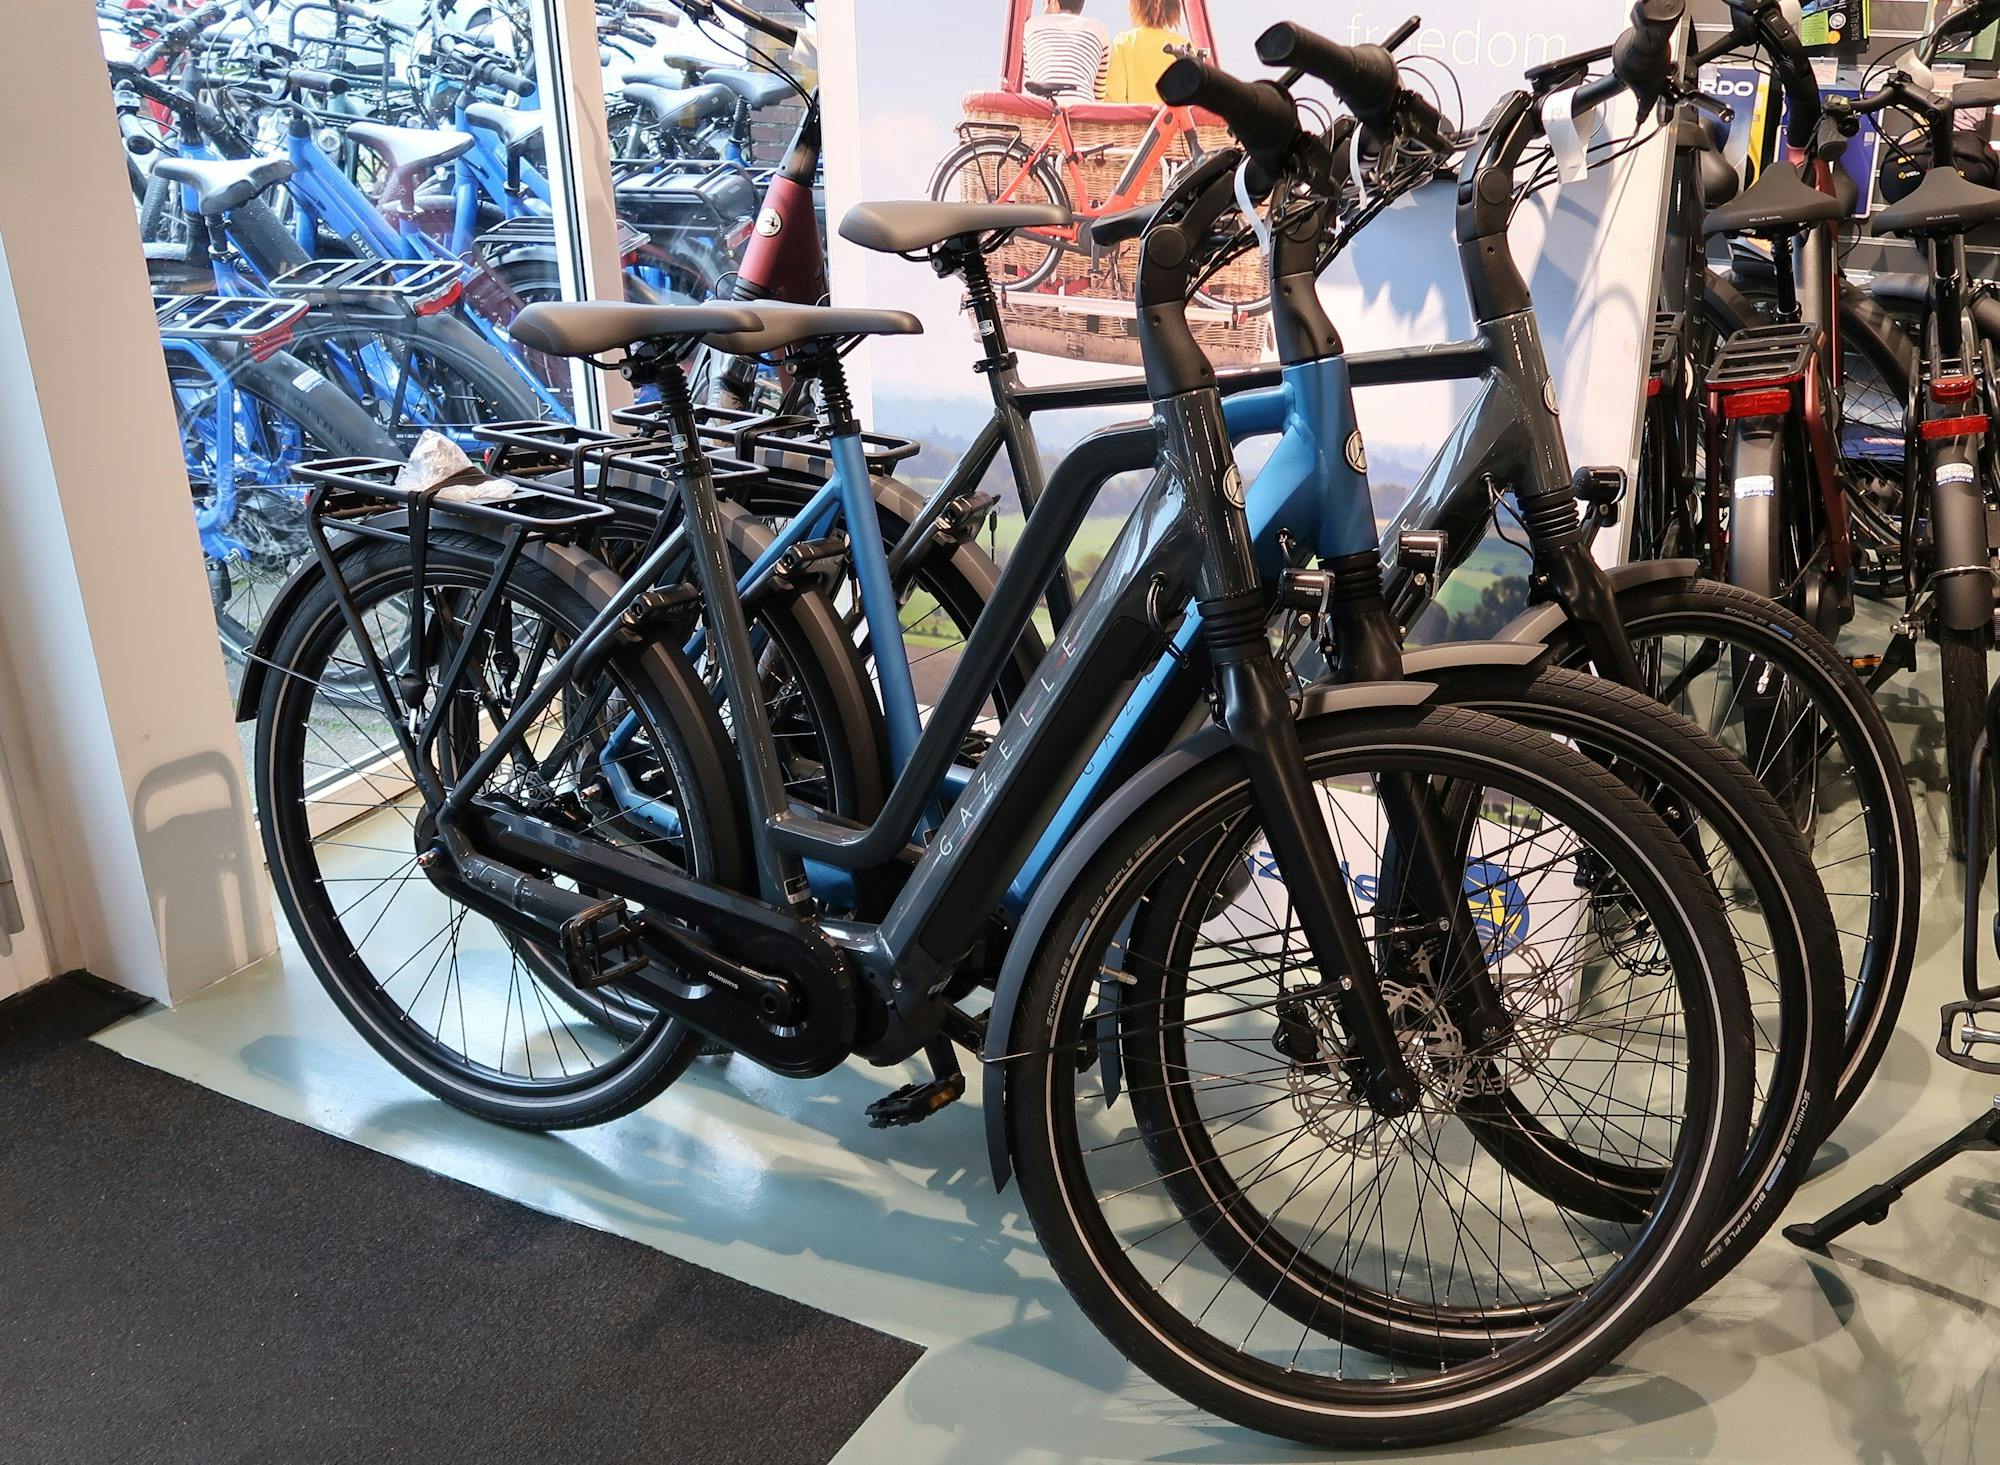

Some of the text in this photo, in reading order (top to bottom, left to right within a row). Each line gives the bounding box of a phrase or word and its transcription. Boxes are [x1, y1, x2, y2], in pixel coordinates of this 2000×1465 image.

[1346, 11, 1568, 68] fredom
[1700, 80, 1754, 97] RDO
[351, 233, 377, 260] GAZE
[939, 636, 1077, 856] GAZELLE
[1046, 857, 1134, 1028] SCHWALBE BIG APPLE
[1723, 1090, 1811, 1247] SCHWALBE BIG APPLE
